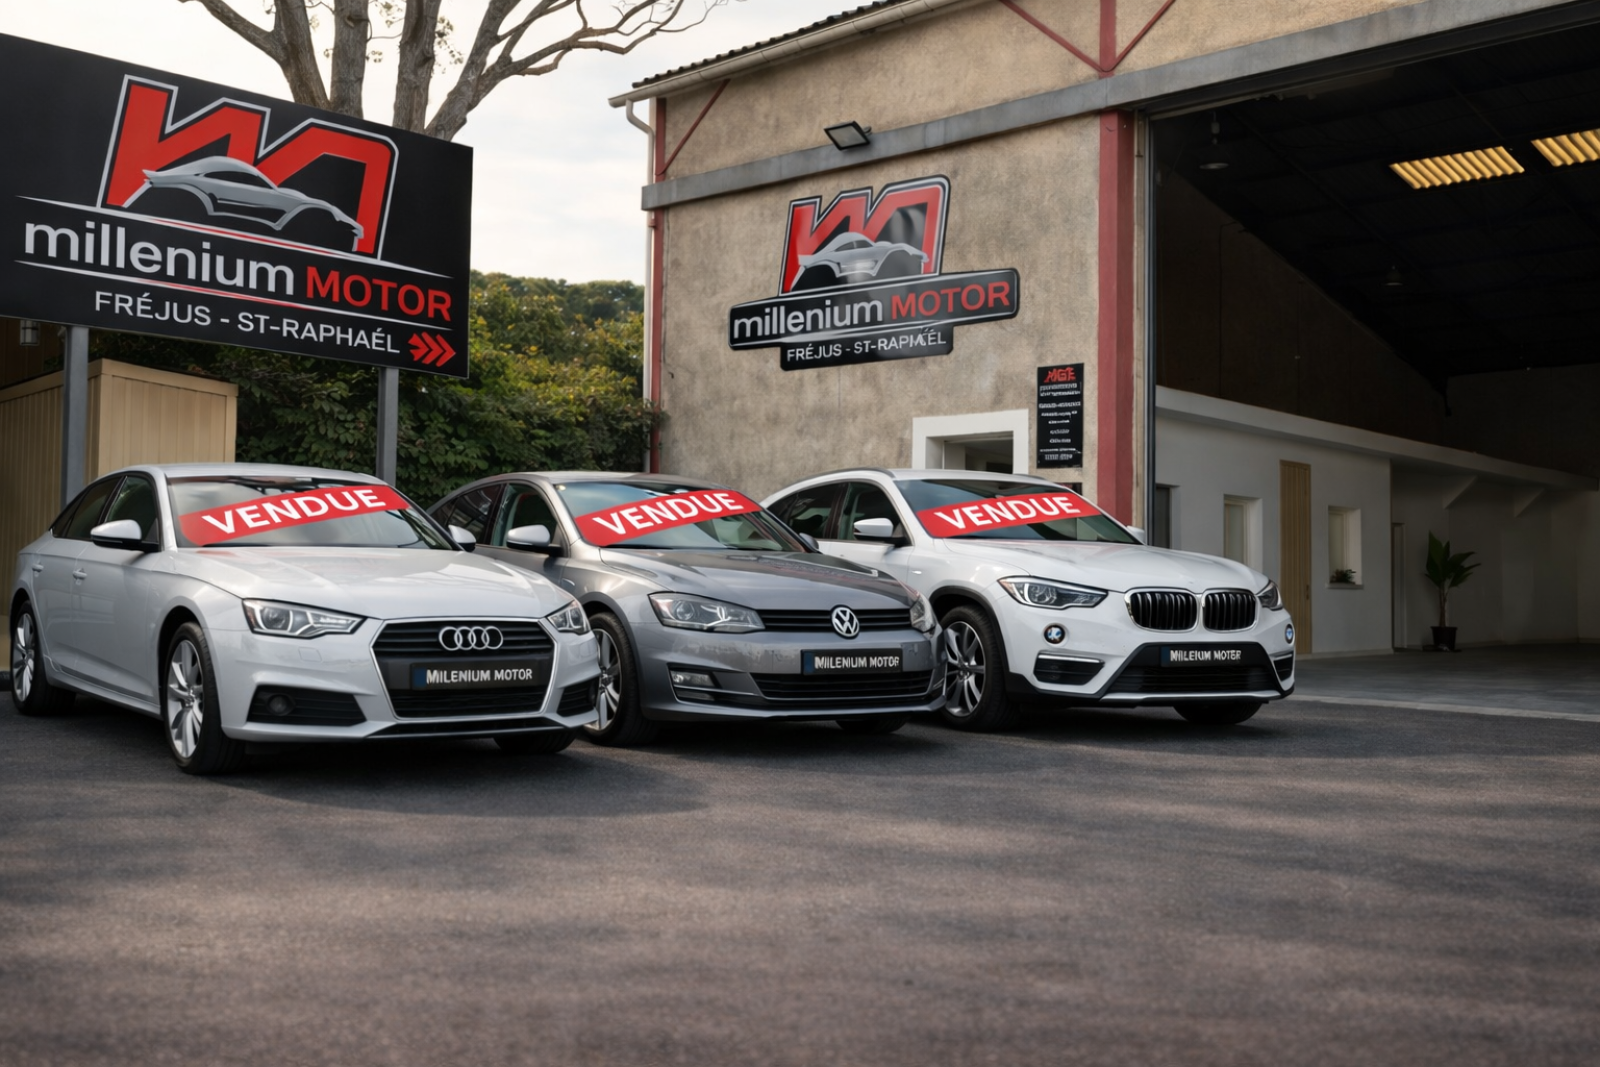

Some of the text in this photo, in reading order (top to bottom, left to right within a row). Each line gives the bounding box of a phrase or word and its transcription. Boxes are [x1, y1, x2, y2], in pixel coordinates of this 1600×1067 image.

[24, 220, 452, 322] millenium MOTOR
[95, 290, 212, 327] FRÉJUS
[237, 311, 401, 354] ST-RAPHAÉL
[733, 281, 1011, 339] millenium MOTOR
[786, 343, 842, 362] FRÉJUS
[201, 489, 386, 534] VENDUE
[593, 491, 745, 536] VENDUE
[934, 496, 1081, 530] VENDUE
[426, 668, 533, 684] MILENIUM MOTOR
[869, 656, 900, 668] MOTOR
